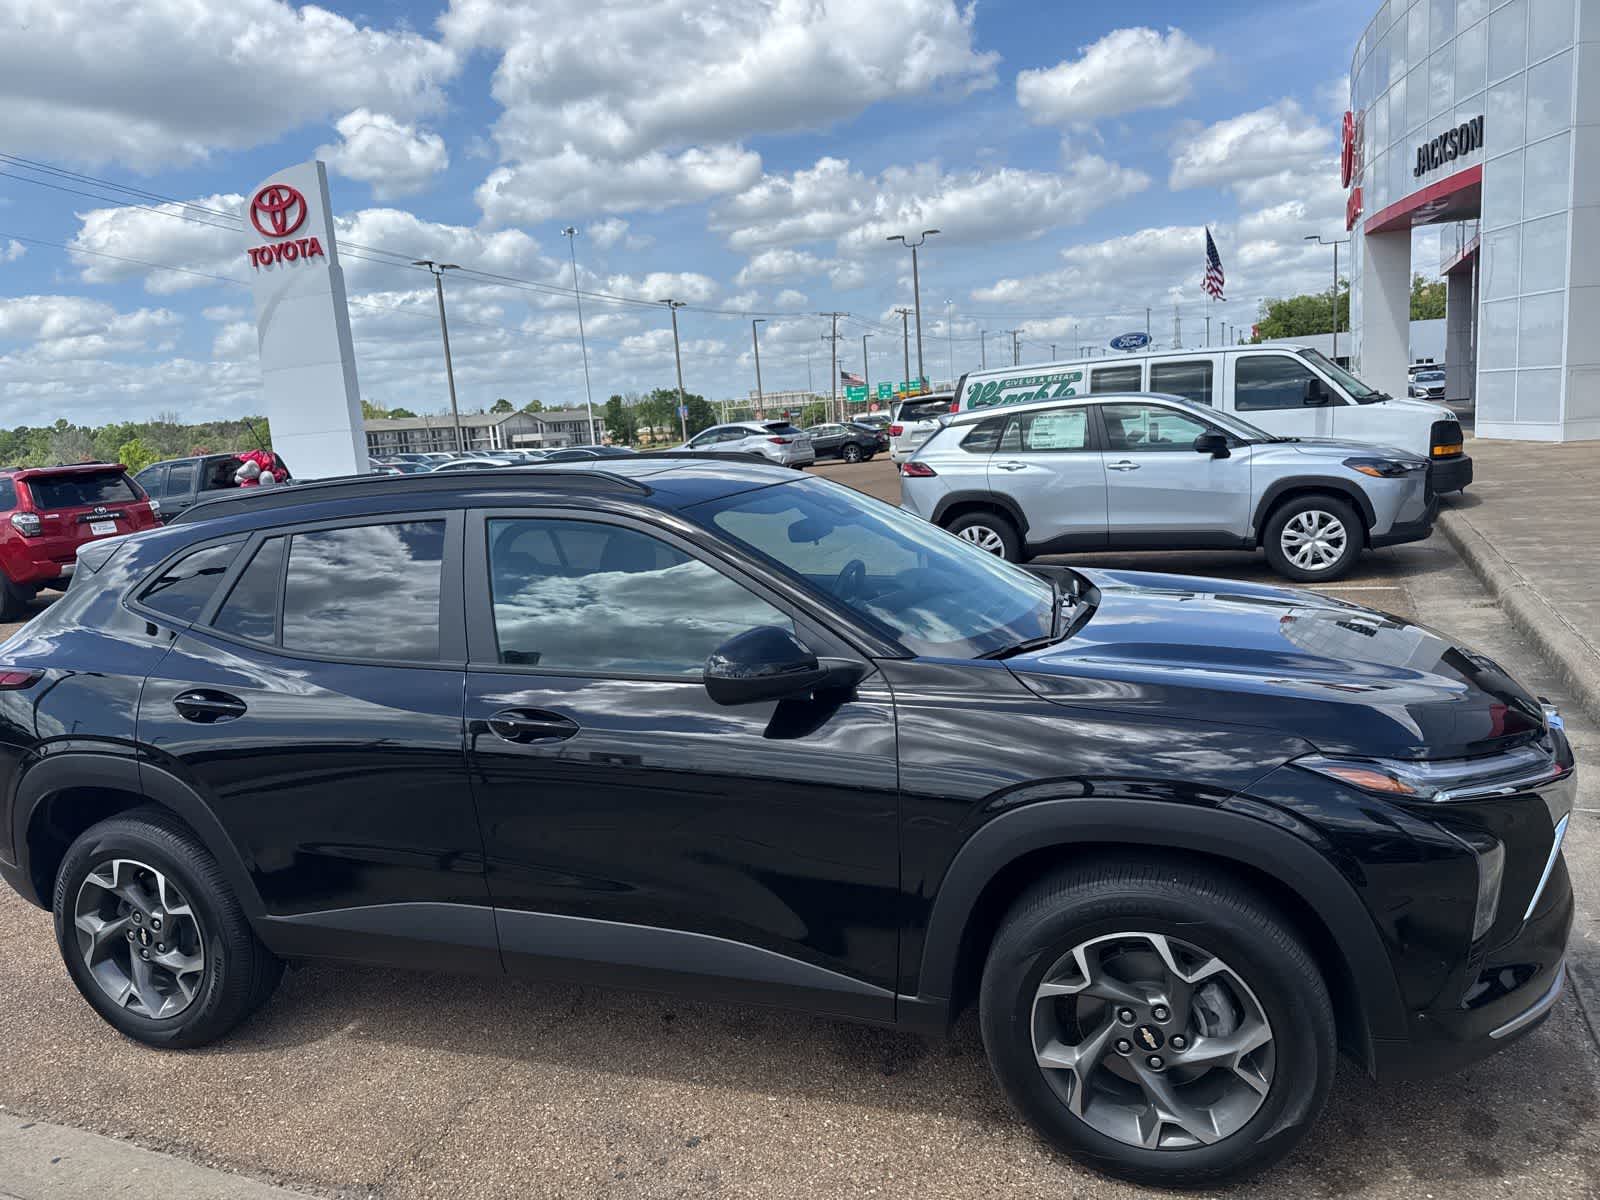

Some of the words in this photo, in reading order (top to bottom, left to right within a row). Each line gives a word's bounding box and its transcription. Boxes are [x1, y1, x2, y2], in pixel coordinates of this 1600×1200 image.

[1414, 115, 1484, 177] JACKSON
[247, 237, 325, 268] TOYOTA
[1005, 378, 1023, 387] GIVE
[1047, 373, 1075, 382] BREAK
